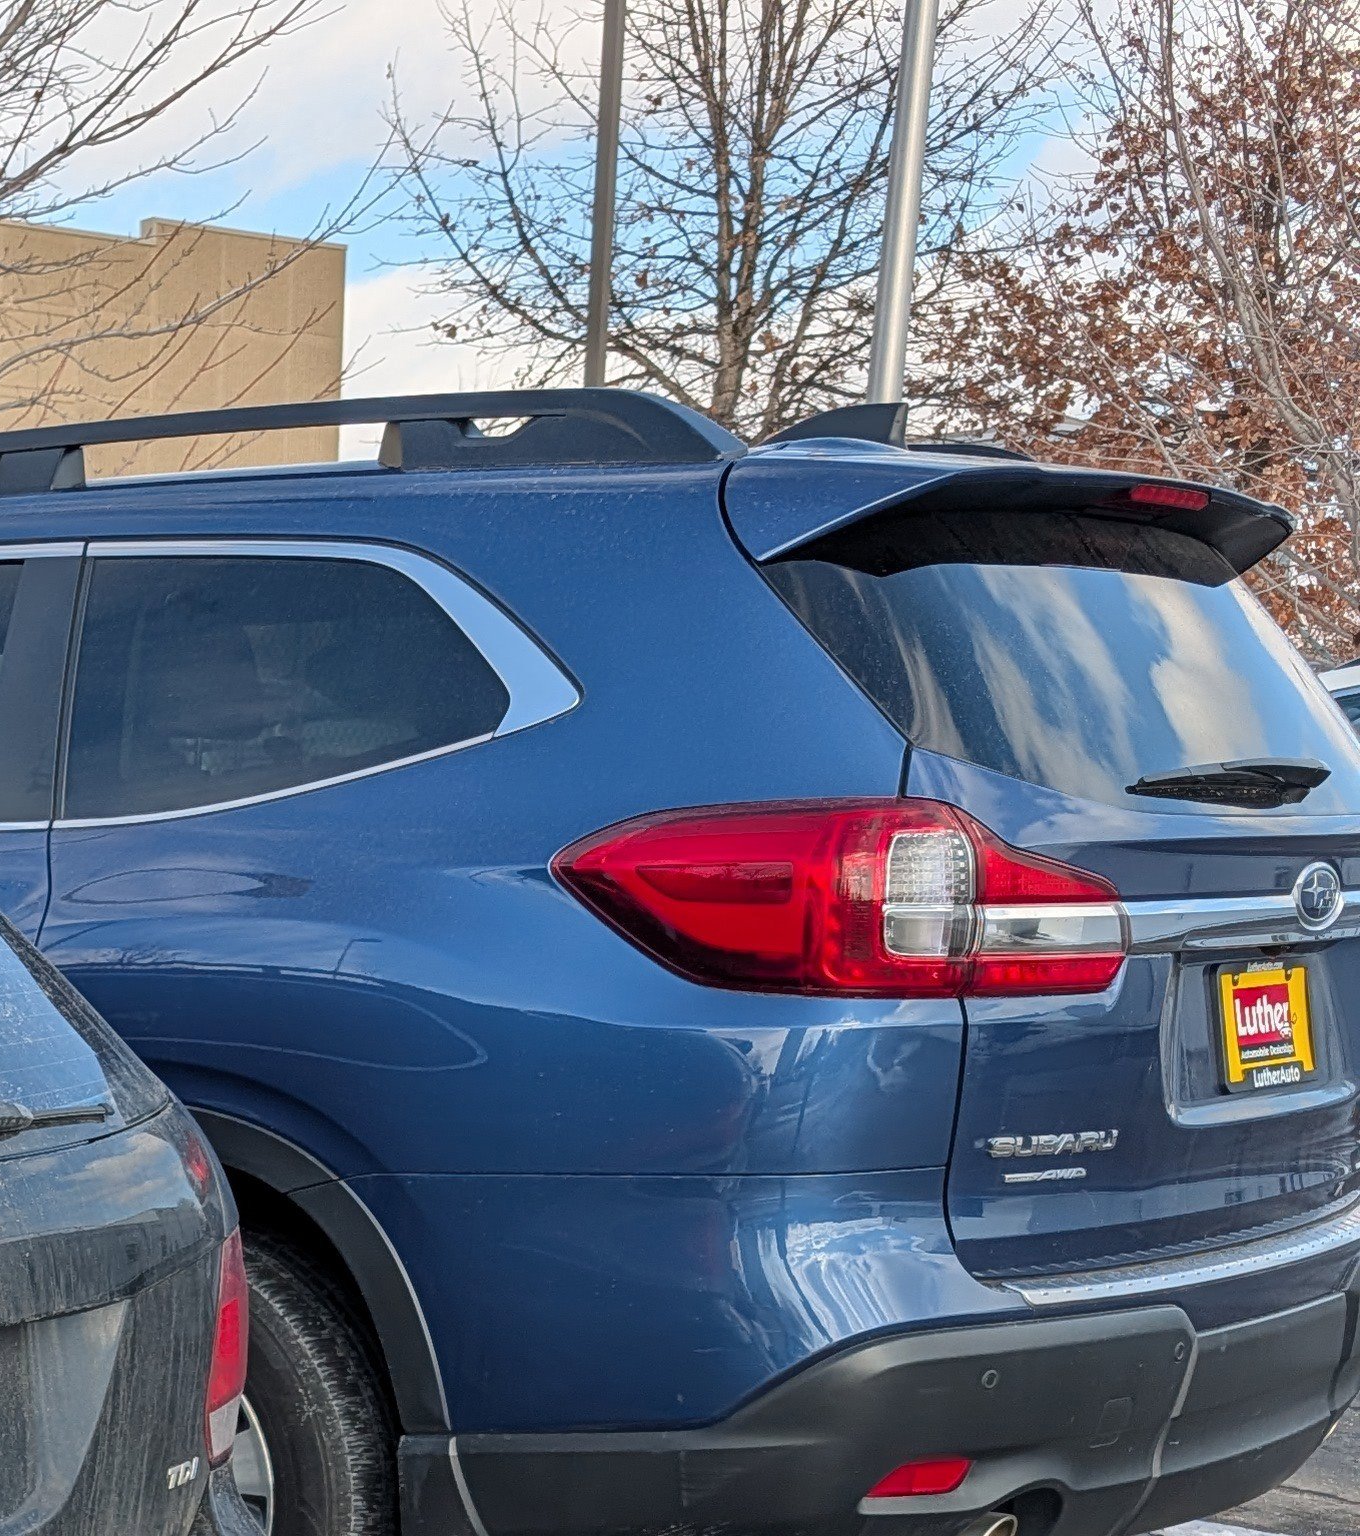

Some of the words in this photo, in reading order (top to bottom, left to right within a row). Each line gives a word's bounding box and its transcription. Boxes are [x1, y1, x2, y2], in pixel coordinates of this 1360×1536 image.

[1235, 994, 1289, 1037] Luther
[1252, 1065, 1301, 1088] LutherAuto
[988, 1129, 1120, 1158] SUBARU
[167, 1456, 199, 1490] TDI
